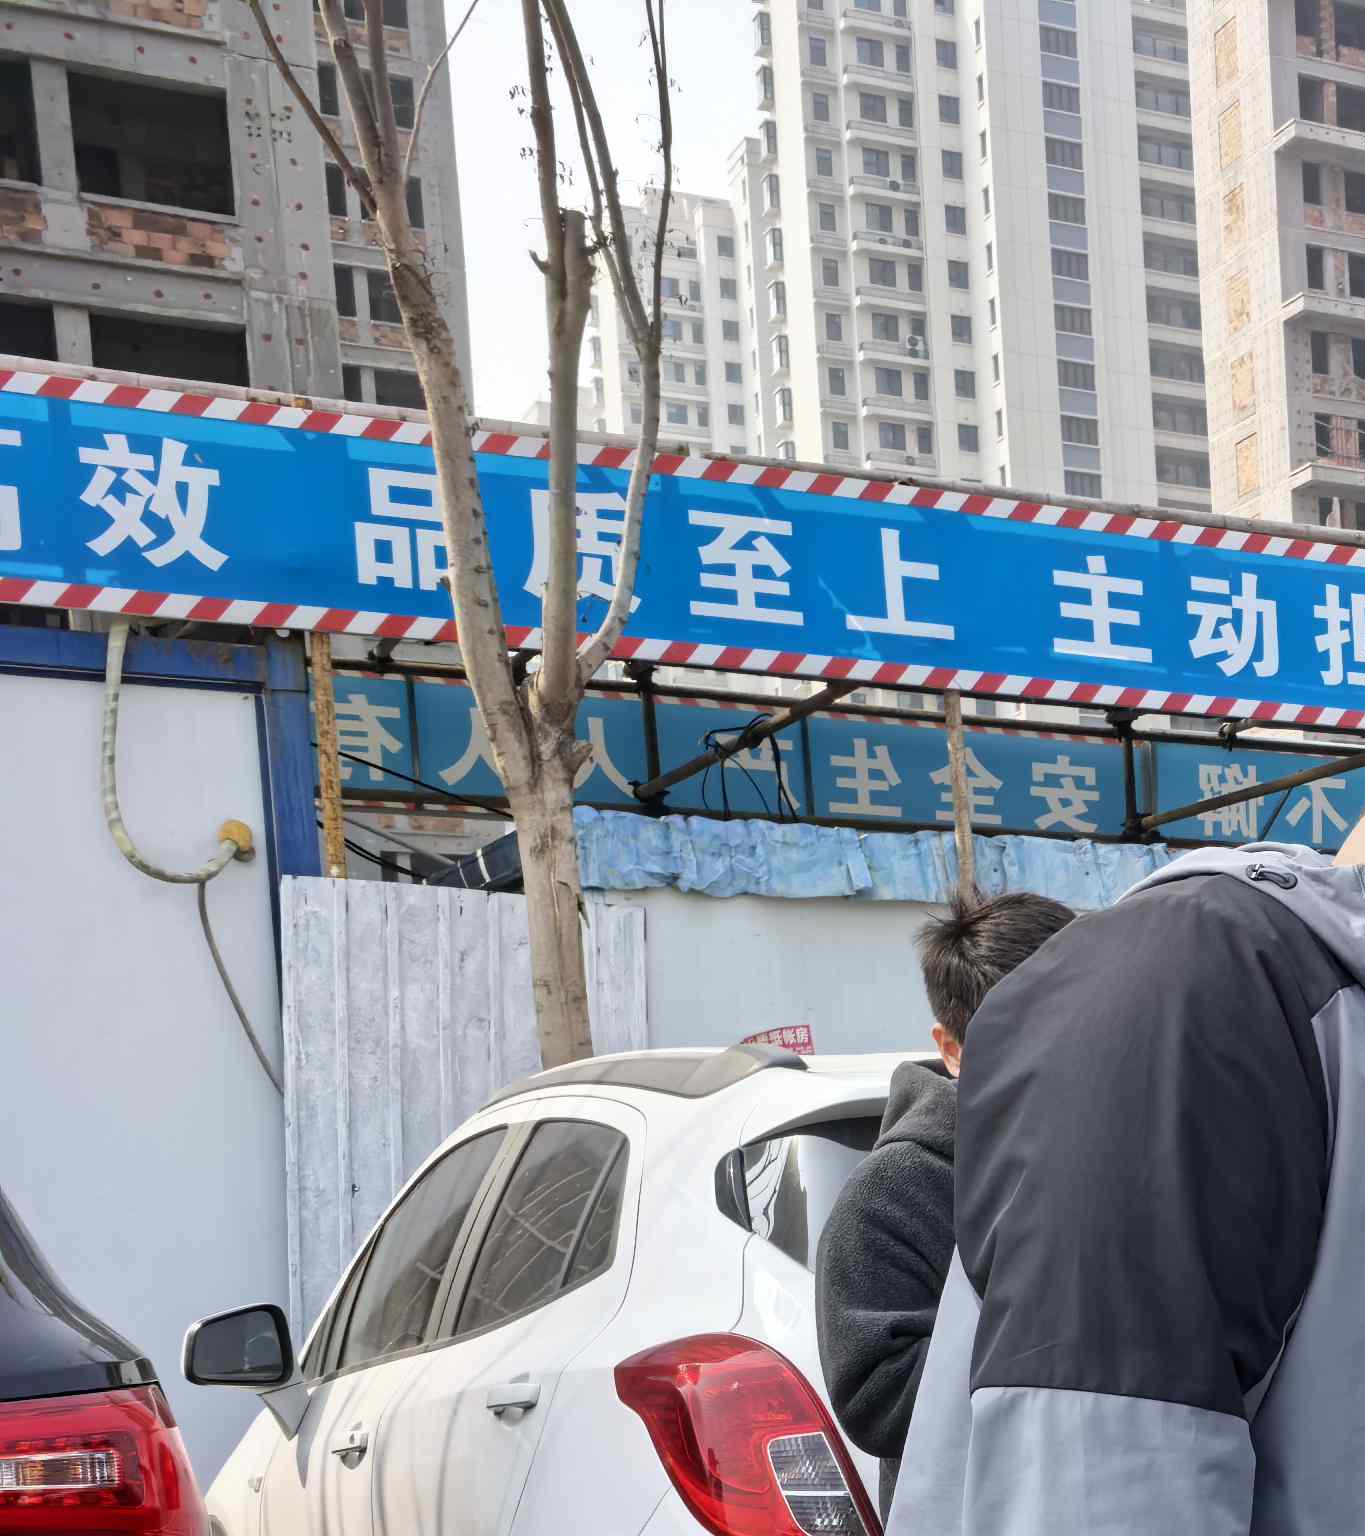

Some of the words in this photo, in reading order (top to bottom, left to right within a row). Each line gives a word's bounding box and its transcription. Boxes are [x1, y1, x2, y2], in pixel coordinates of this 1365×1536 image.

[0, 430, 229, 572] 效
[357, 467, 955, 641] 品质至上
